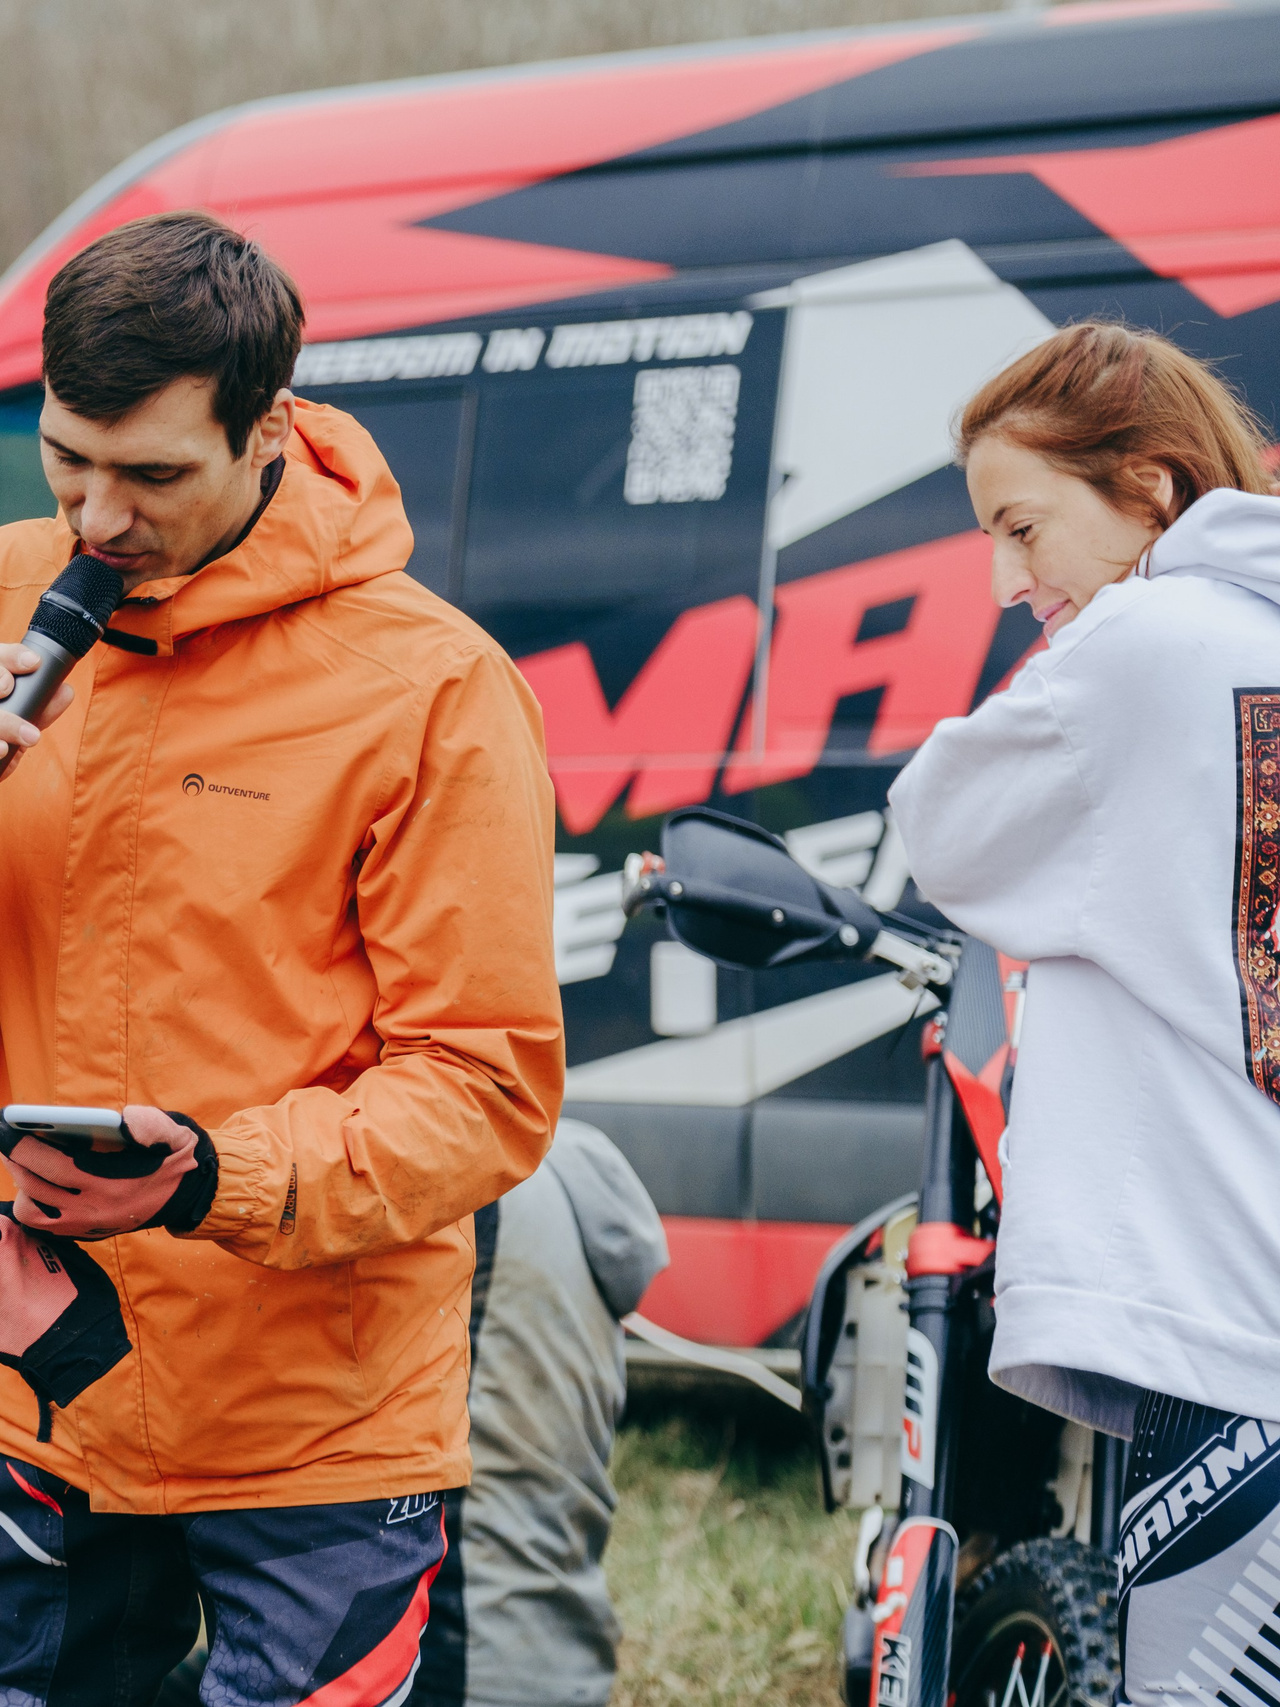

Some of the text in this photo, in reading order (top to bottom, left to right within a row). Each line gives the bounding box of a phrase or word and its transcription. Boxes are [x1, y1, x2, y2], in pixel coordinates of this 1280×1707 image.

[482, 326, 546, 373] IN
[547, 311, 753, 368] MOTION
[208, 783, 271, 801] OUTVENTURE
